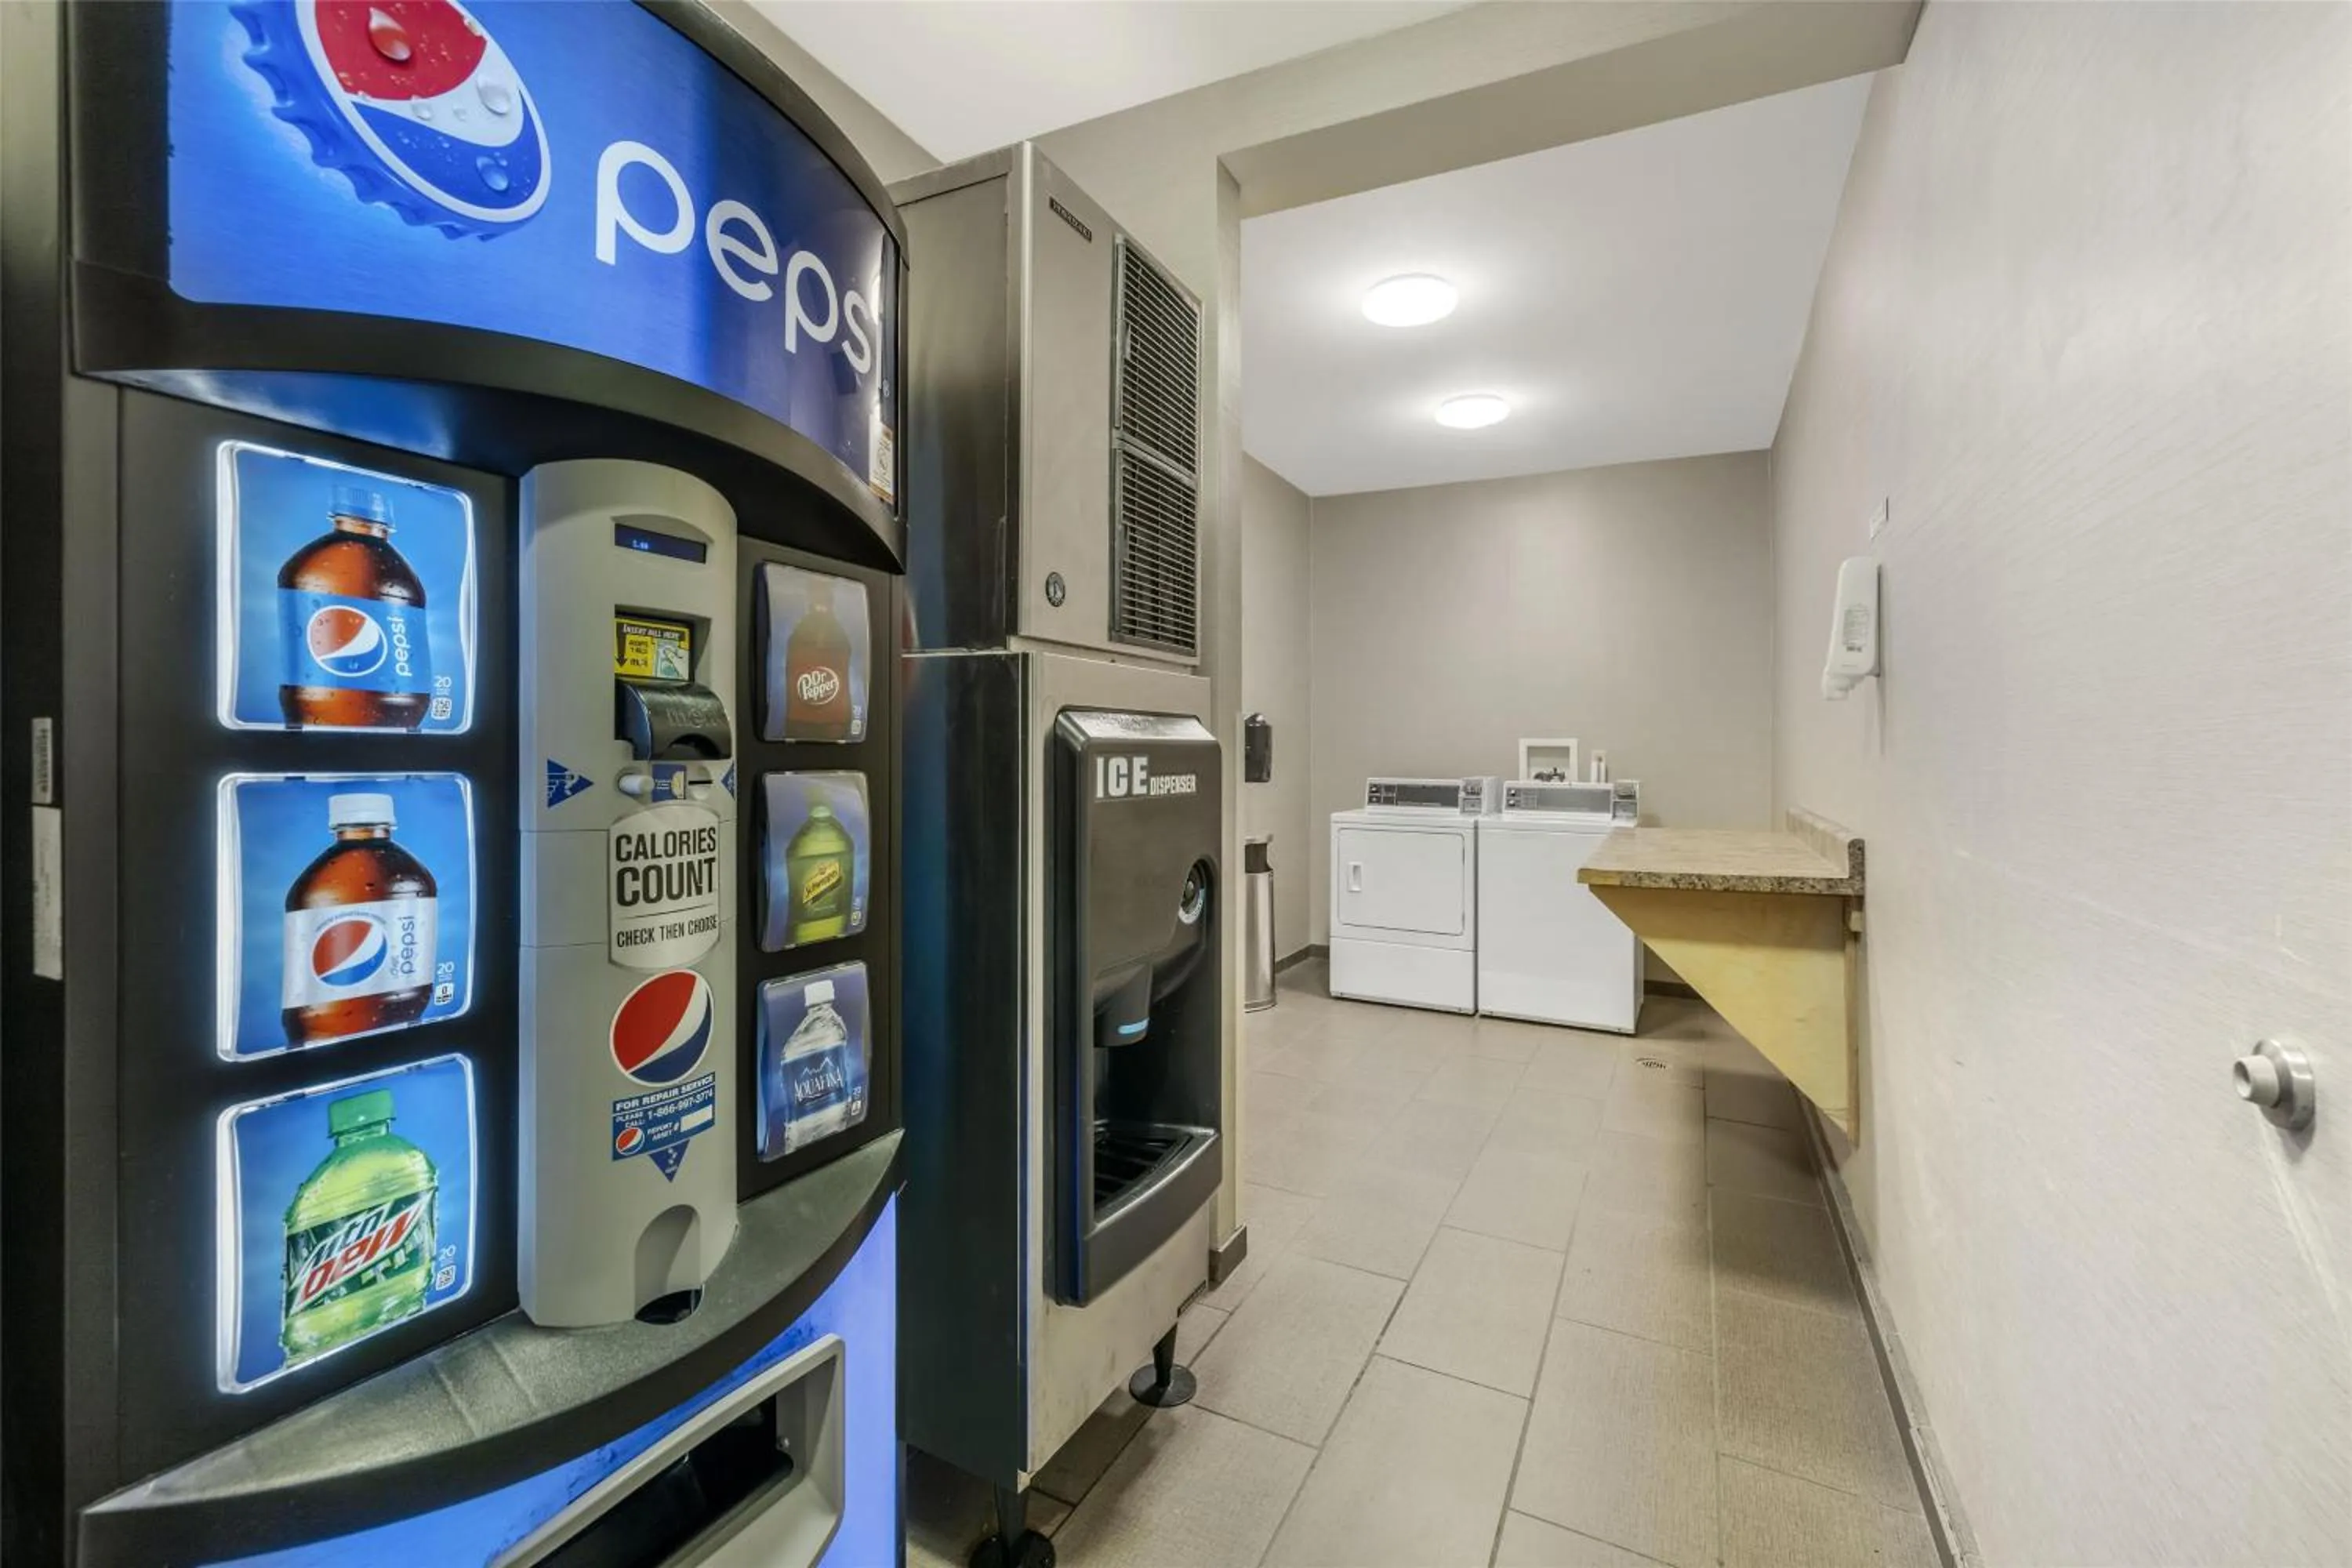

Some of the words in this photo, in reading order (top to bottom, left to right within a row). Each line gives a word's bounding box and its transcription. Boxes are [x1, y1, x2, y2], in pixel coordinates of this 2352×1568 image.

[387, 615, 413, 677] pepsi
[801, 674, 834, 700] Pepper
[811, 670, 826, 685] Dr
[1096, 756, 1149, 798] ICE
[1150, 774, 1196, 796] DISPENSER
[615, 826, 717, 862] CALORIES
[616, 857, 717, 907] COUNT
[397, 916, 417, 975] pepsi
[617, 927, 655, 948] CHECK
[659, 923, 685, 941] THEN
[688, 915, 717, 935] CHOOSE
[437, 962, 454, 975] 20
[615, 1099, 640, 1112] FOR
[642, 1087, 679, 1105] REPAIR
[681, 1075, 713, 1093] SERVICE
[794, 1066, 844, 1103] AQUAFINA
